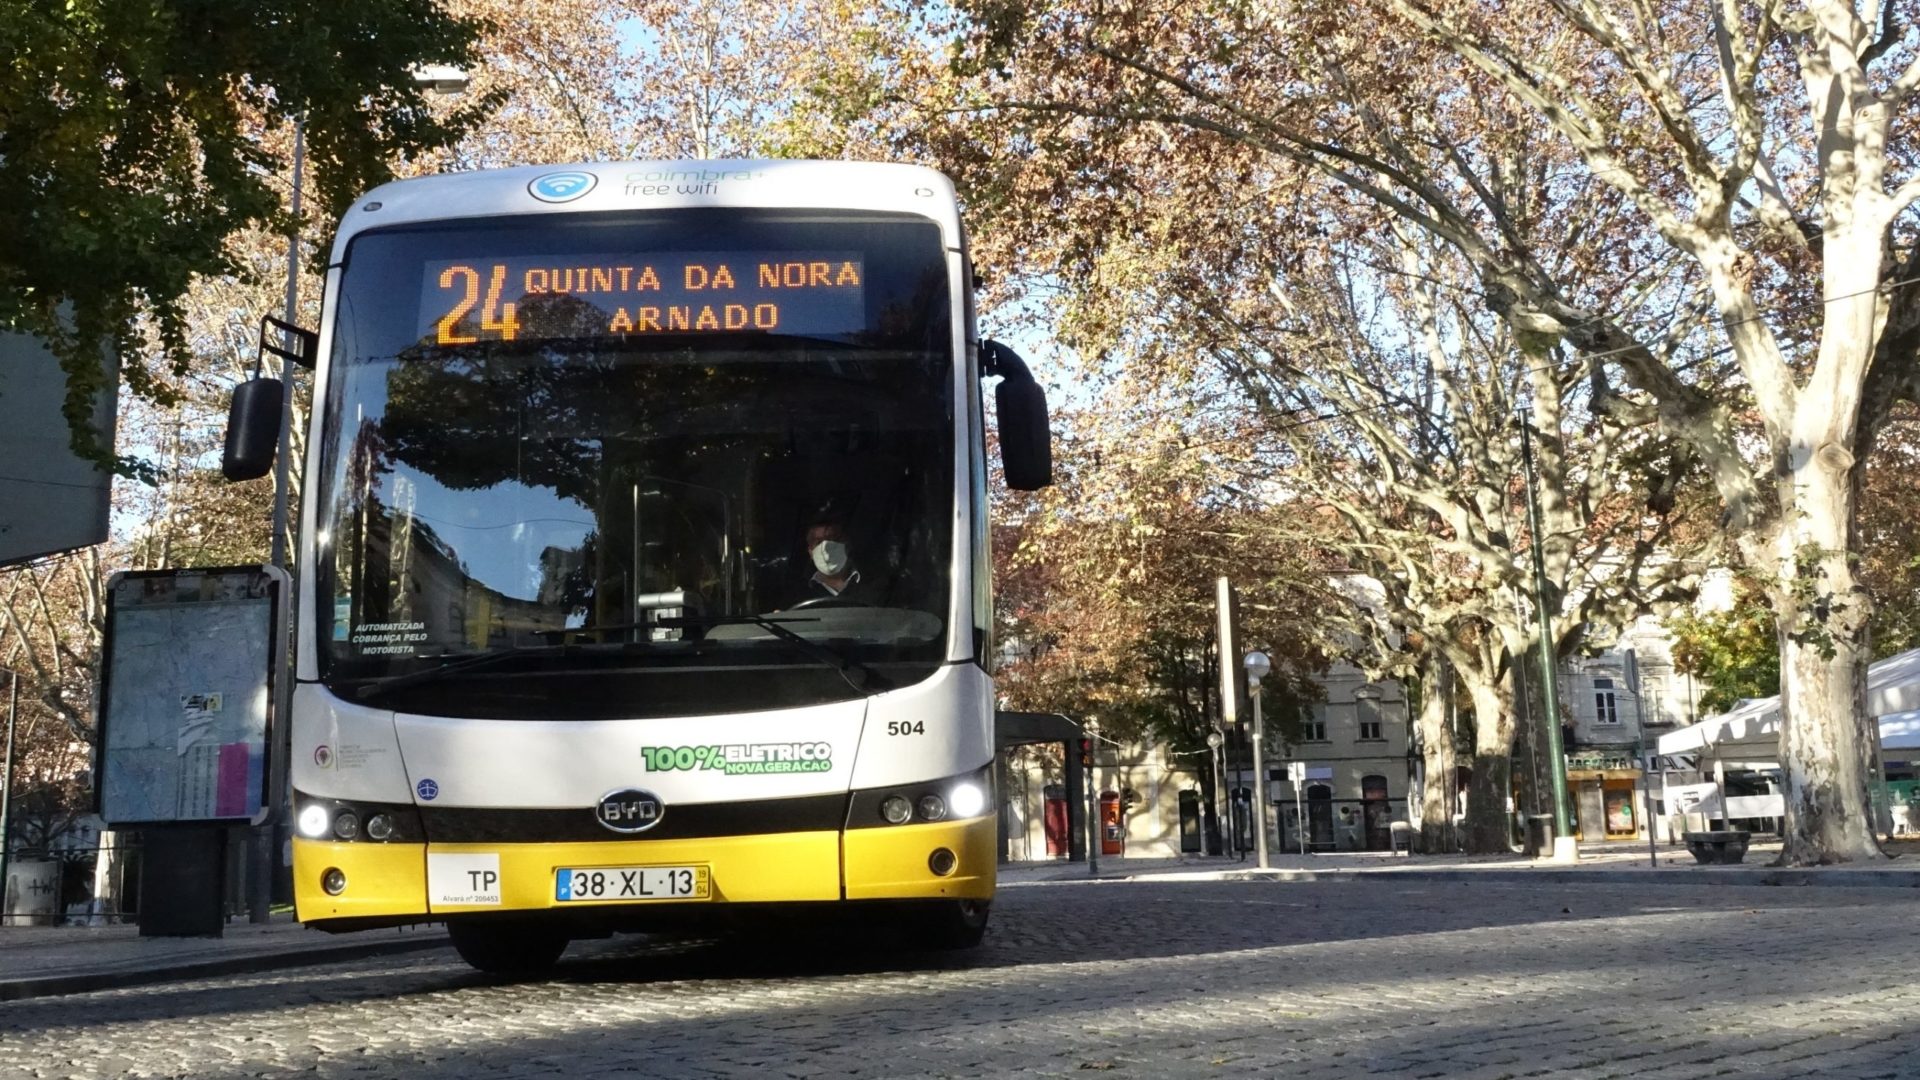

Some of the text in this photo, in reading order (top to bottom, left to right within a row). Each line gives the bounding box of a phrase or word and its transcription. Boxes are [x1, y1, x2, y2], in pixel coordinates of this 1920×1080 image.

[624, 180, 719, 196] free wifi
[524, 260, 861, 295] QUINTA DA NORA
[437, 264, 521, 344] 24
[610, 302, 780, 332] ARNADO
[355, 622, 425, 632] AUTOMATIZADA
[352, 633, 428, 645] COBRANÇA PELO
[362, 645, 415, 655] MOTORISTA
[888, 720, 925, 736] 504
[641, 745, 727, 772] 100%
[604, 801, 656, 820] BYD
[467, 870, 497, 892] TP
